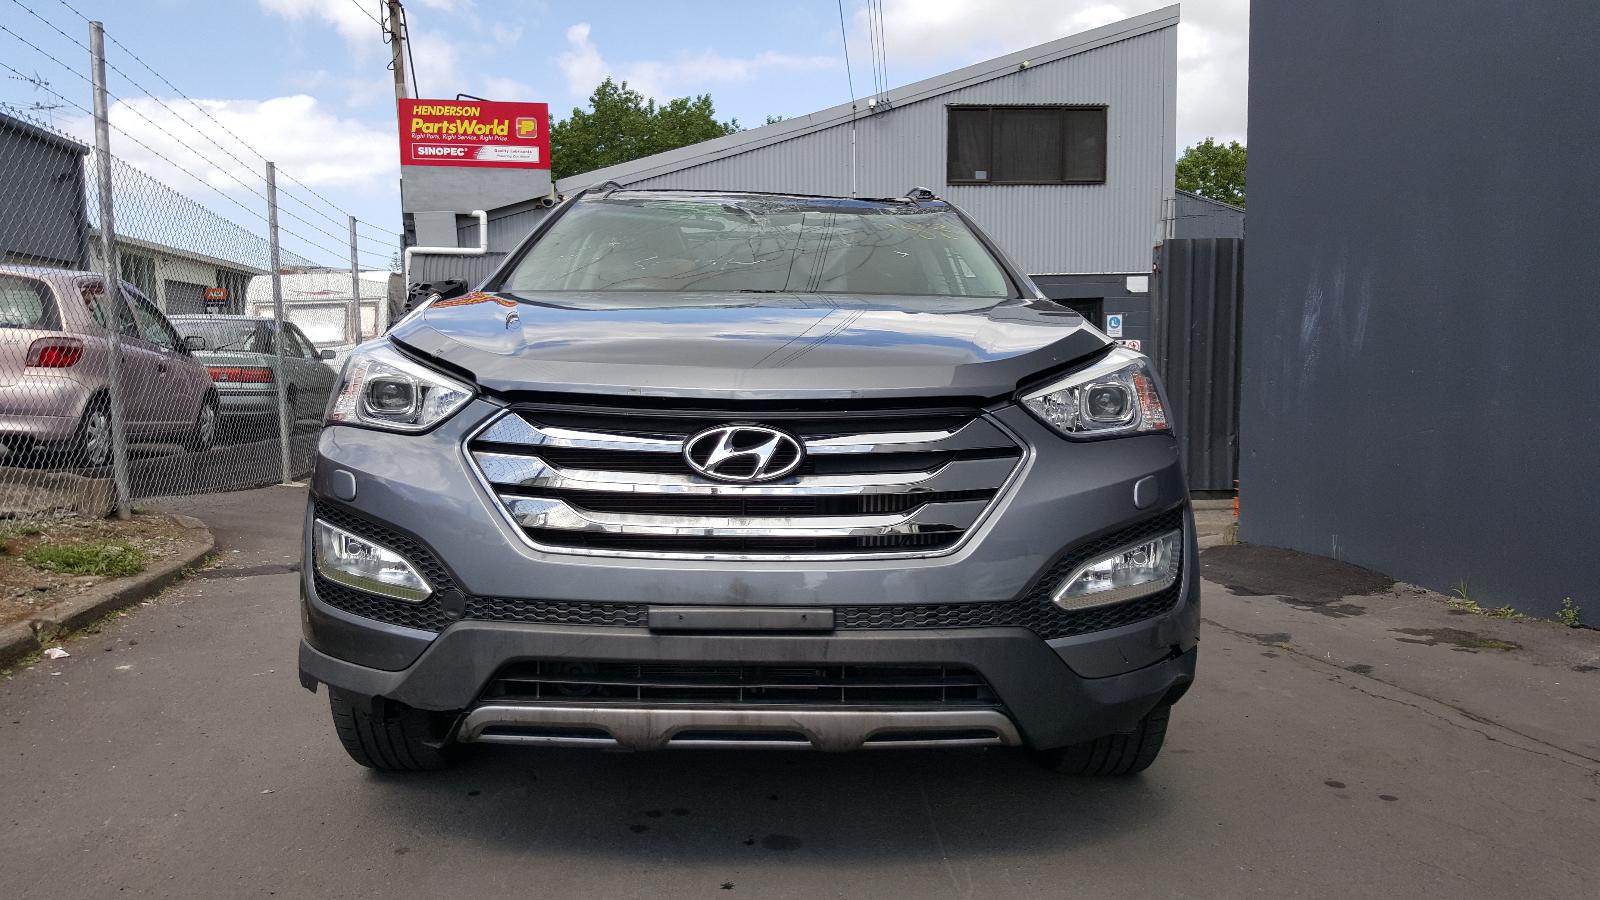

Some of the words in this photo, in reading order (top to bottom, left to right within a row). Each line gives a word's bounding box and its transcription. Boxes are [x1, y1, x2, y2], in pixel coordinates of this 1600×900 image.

[413, 105, 480, 116] HENDERSON
[411, 118, 509, 136] PartsWorld
[418, 146, 464, 156] SINOPEC
